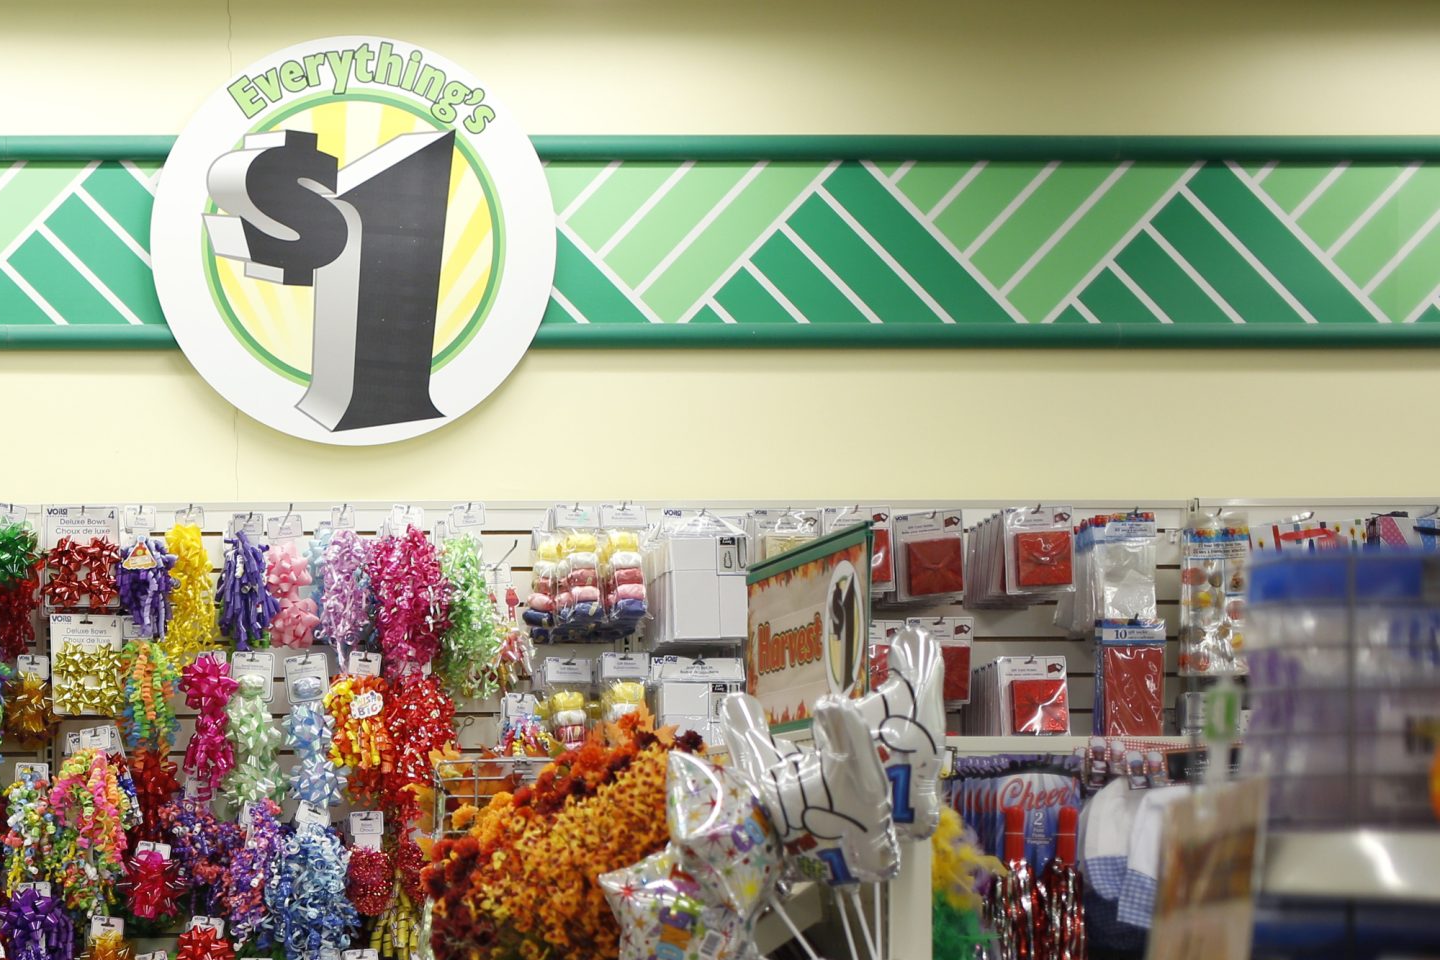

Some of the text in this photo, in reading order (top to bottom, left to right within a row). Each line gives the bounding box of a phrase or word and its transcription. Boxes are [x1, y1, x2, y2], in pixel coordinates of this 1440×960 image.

[227, 42, 496, 134] Everything's
[202, 129, 457, 432] $1
[108, 511, 115, 520] 4
[759, 612, 823, 676] Harvest
[1114, 629, 1127, 639] 10
[357, 704, 378, 716] BIG
[998, 776, 1077, 812] Cheer!
[1033, 811, 1044, 826] 2
